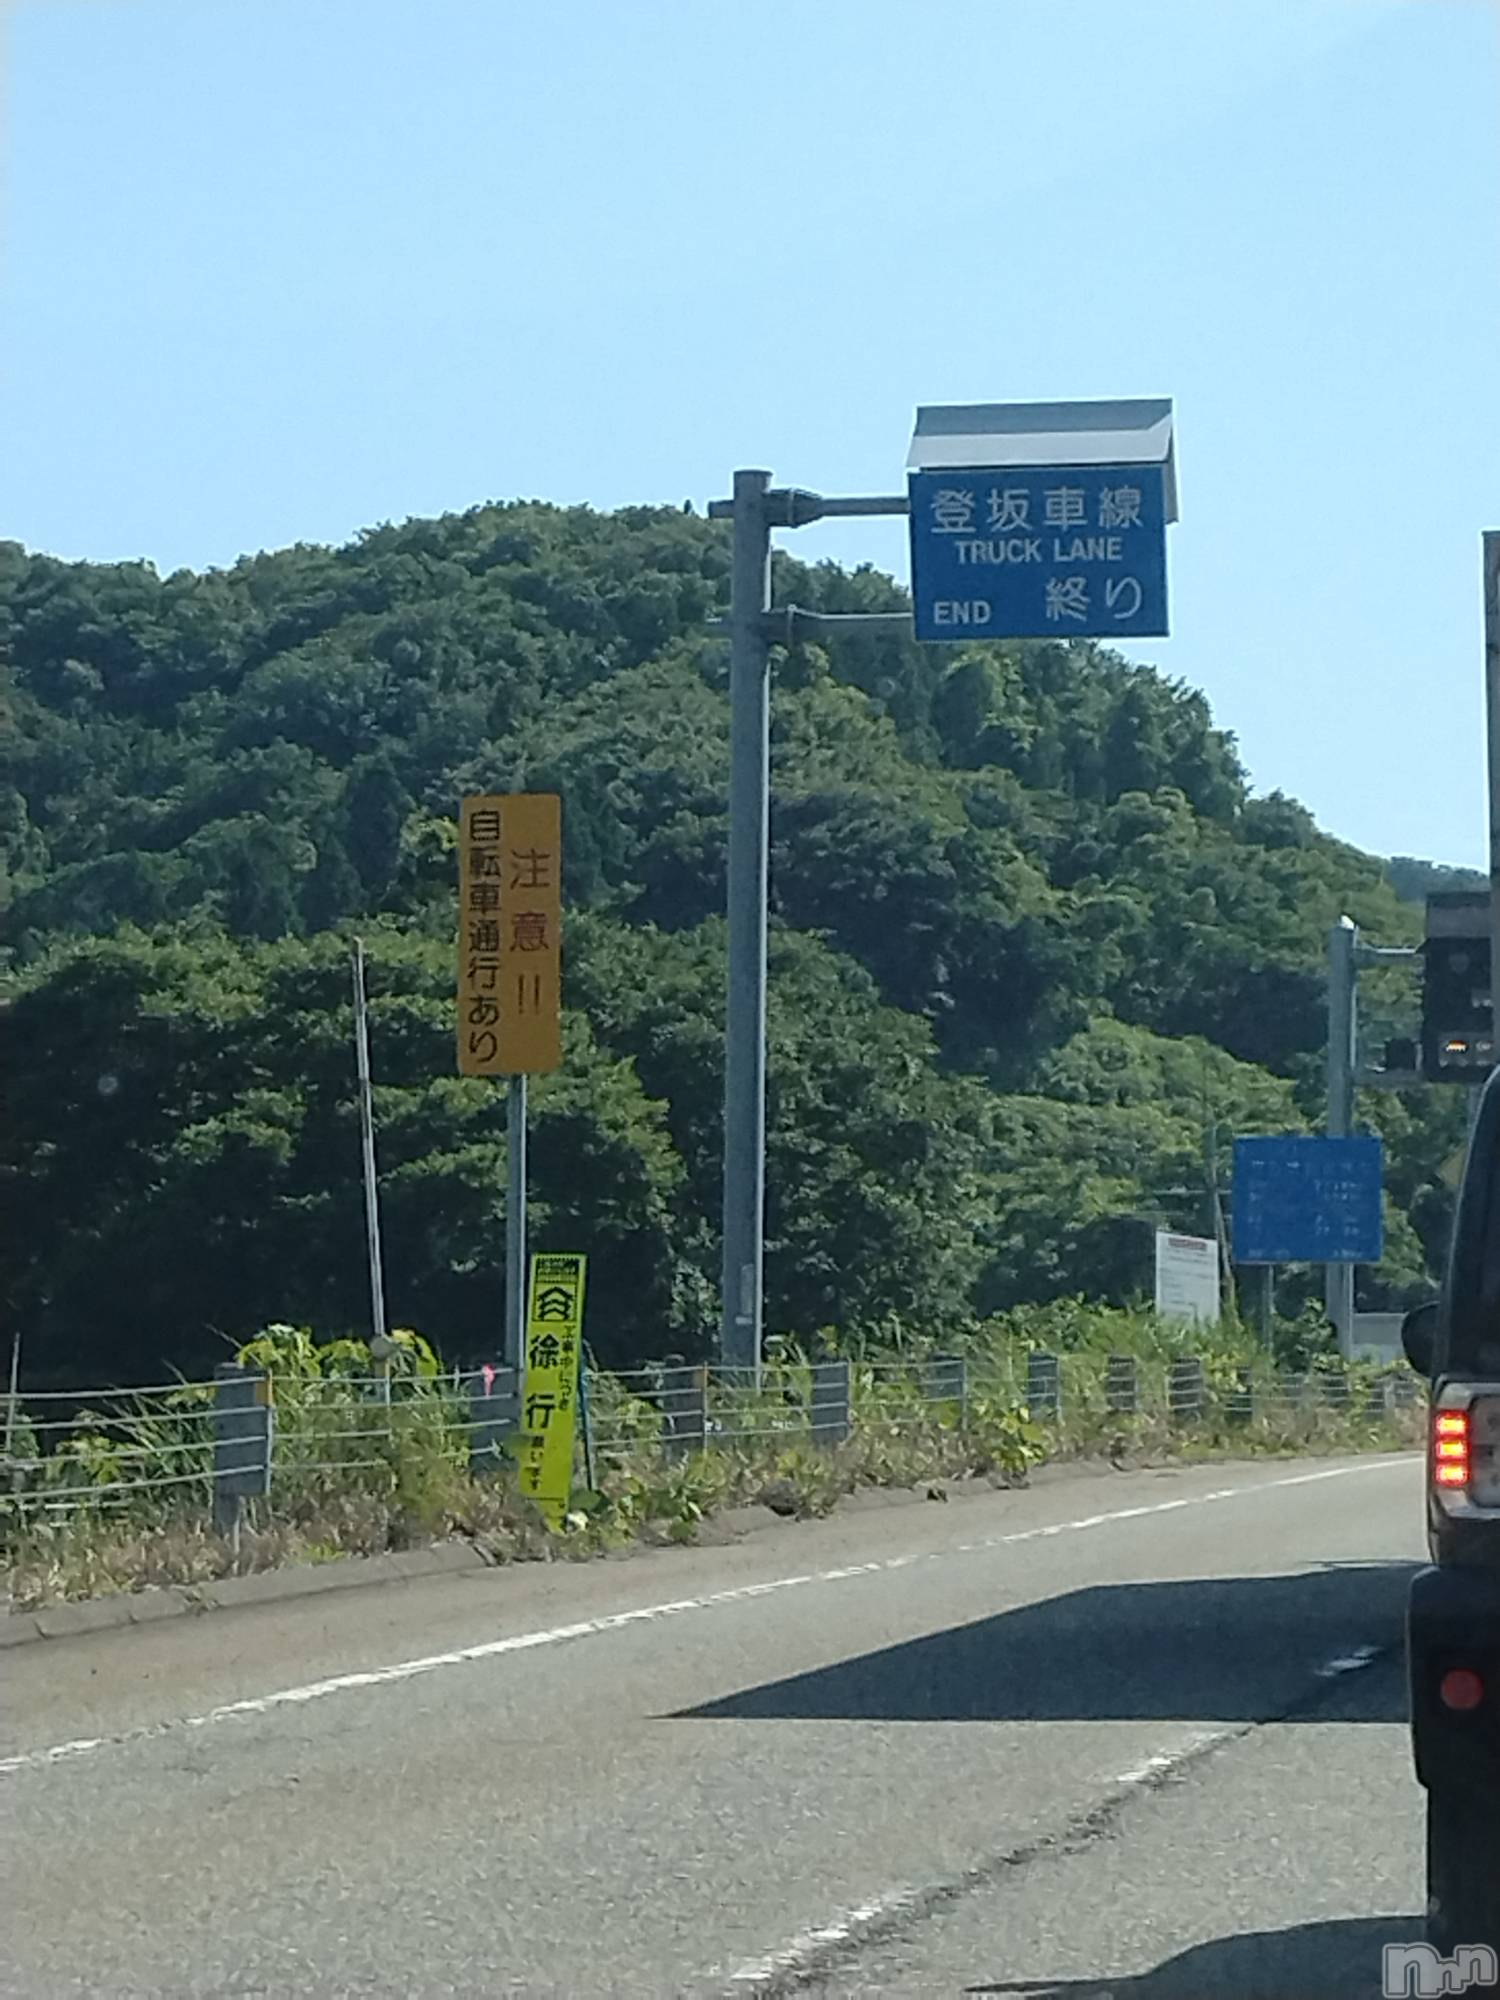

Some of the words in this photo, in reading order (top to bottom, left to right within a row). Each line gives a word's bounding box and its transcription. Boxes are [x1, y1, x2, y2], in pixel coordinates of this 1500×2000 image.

[930, 486, 1144, 535] 登坂車線
[955, 538, 1042, 564] TRUCK
[1053, 537, 1123, 562] LANE
[933, 601, 991, 625] END
[1045, 576, 1142, 622] 終り
[468, 809, 501, 1064] 自転車通行あり
